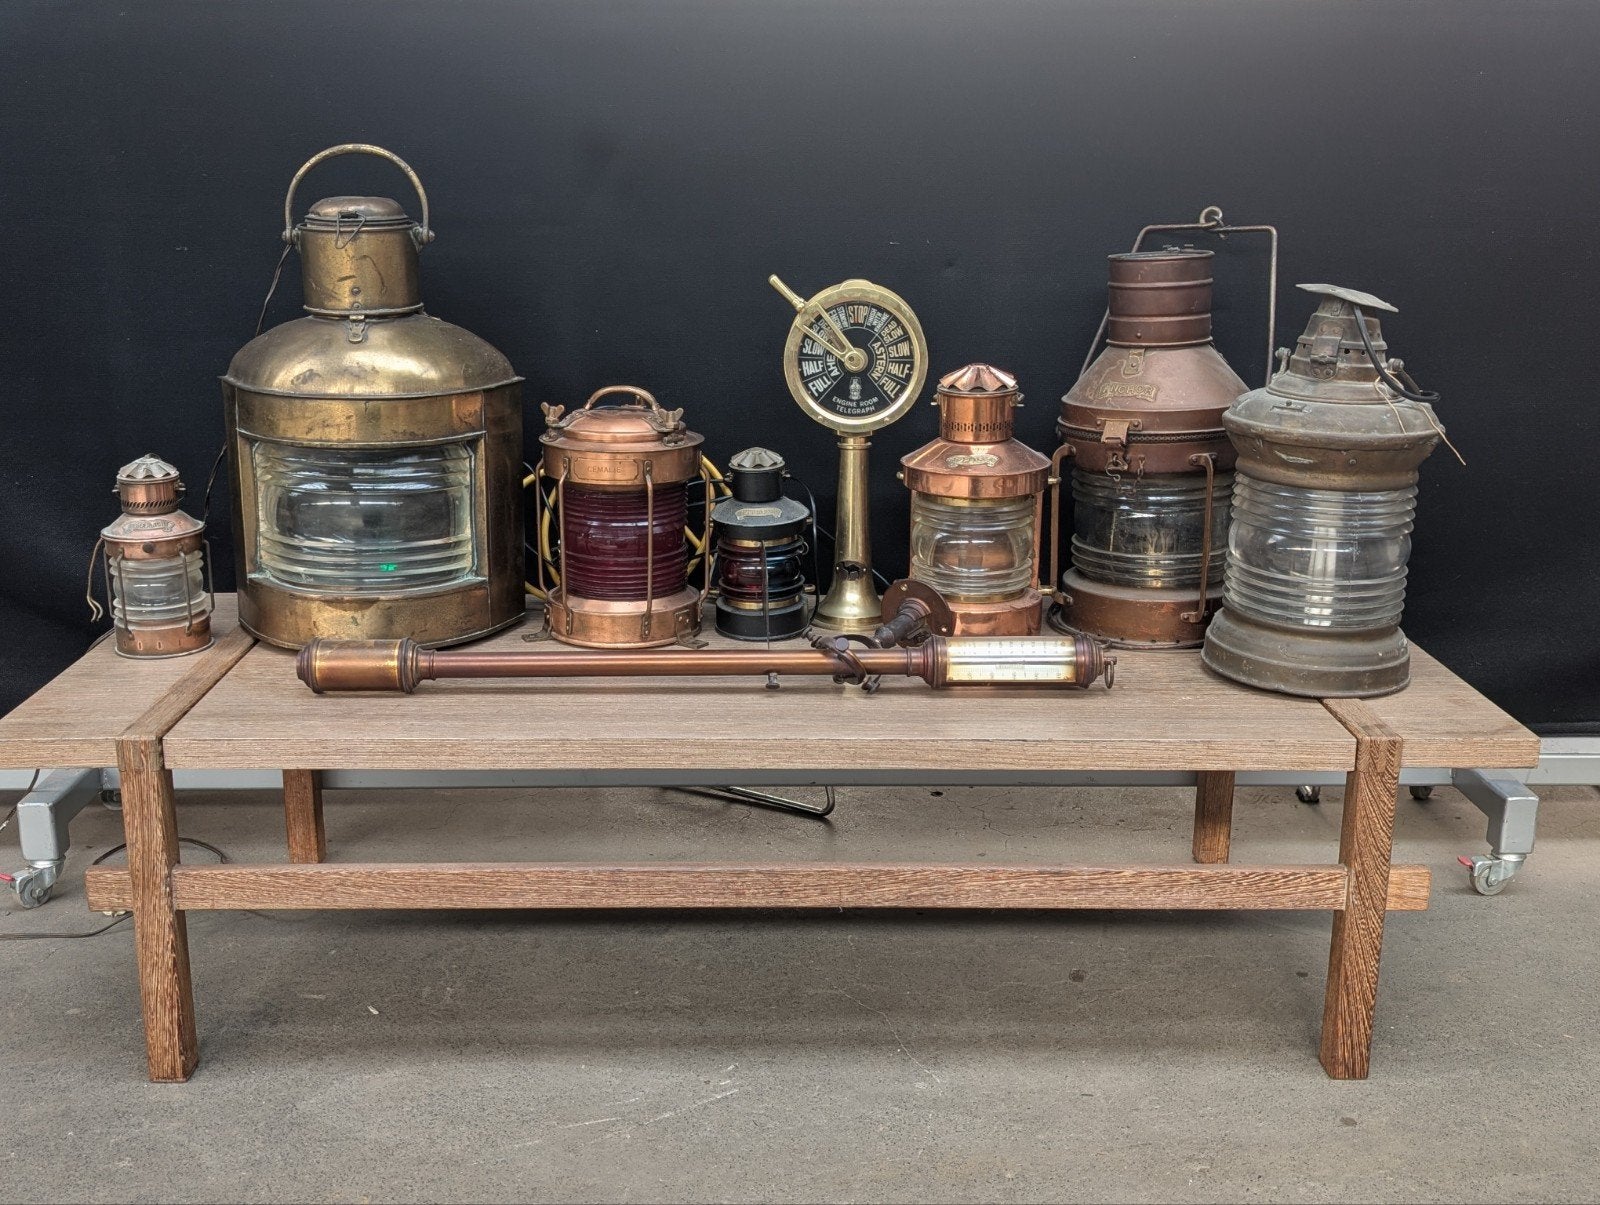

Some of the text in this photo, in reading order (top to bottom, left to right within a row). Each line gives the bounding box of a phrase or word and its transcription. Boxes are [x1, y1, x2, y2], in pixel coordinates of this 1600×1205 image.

[848, 305, 868, 323] STOP
[881, 321, 903, 343] DEAD SLOW
[803, 338, 824, 355] SLOW
[889, 340, 910, 357] SLOW
[802, 361, 823, 376] HALF
[827, 354, 840, 376] AHE
[872, 342, 886, 380] ASTERN
[888, 363, 910, 378] HALF
[808, 376, 831, 396] FULL
[880, 377, 900, 398] FULL
[1100, 383, 1153, 396] ANCHOR
[832, 396, 879, 407] ENGINE ROOM
[836, 405, 875, 414] TELEGRAPH
